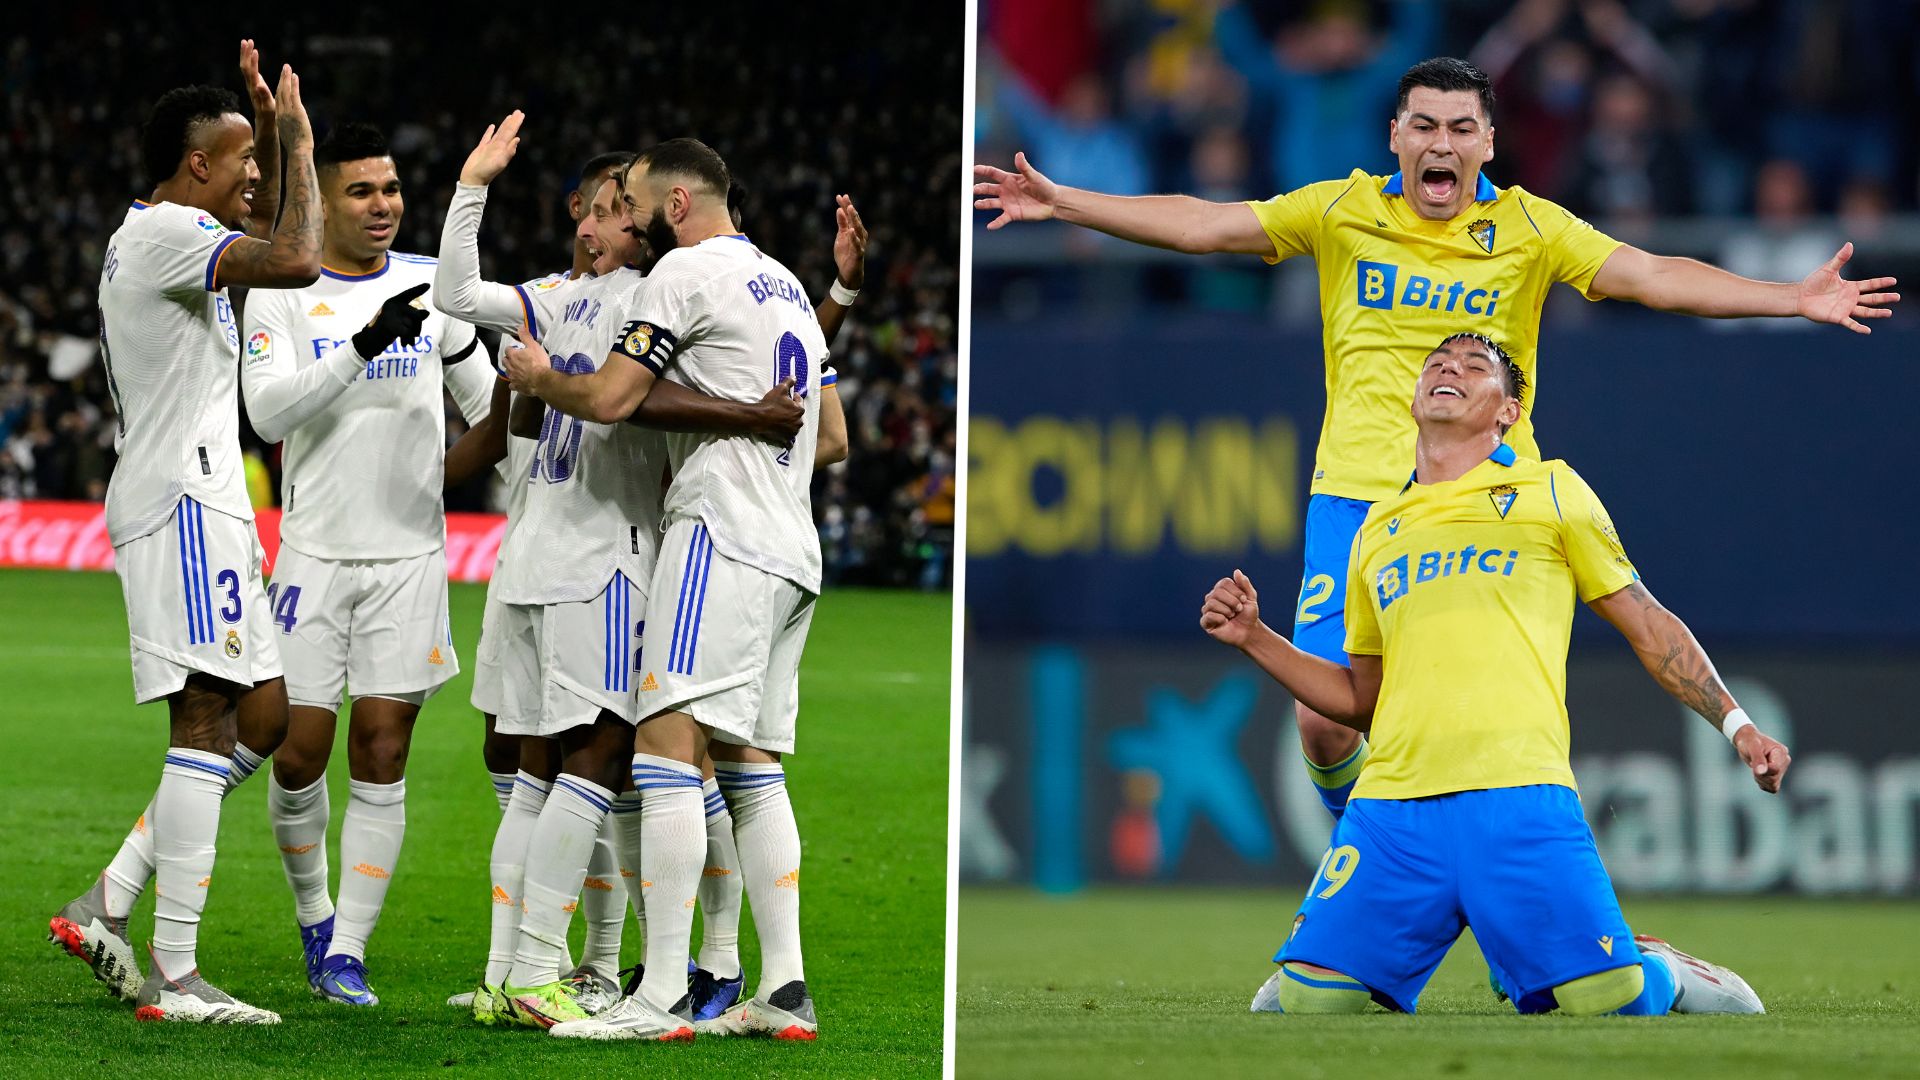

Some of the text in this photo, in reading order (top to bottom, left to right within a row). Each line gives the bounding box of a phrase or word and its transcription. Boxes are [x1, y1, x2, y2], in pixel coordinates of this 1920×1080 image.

[1400, 275, 1500, 317] Bitci
[366, 358, 418, 380] BETTER
[1415, 544, 1519, 584] Bitci
[216, 569, 243, 625] 3
[267, 582, 302, 635] 14
[1295, 574, 1336, 624] 2
